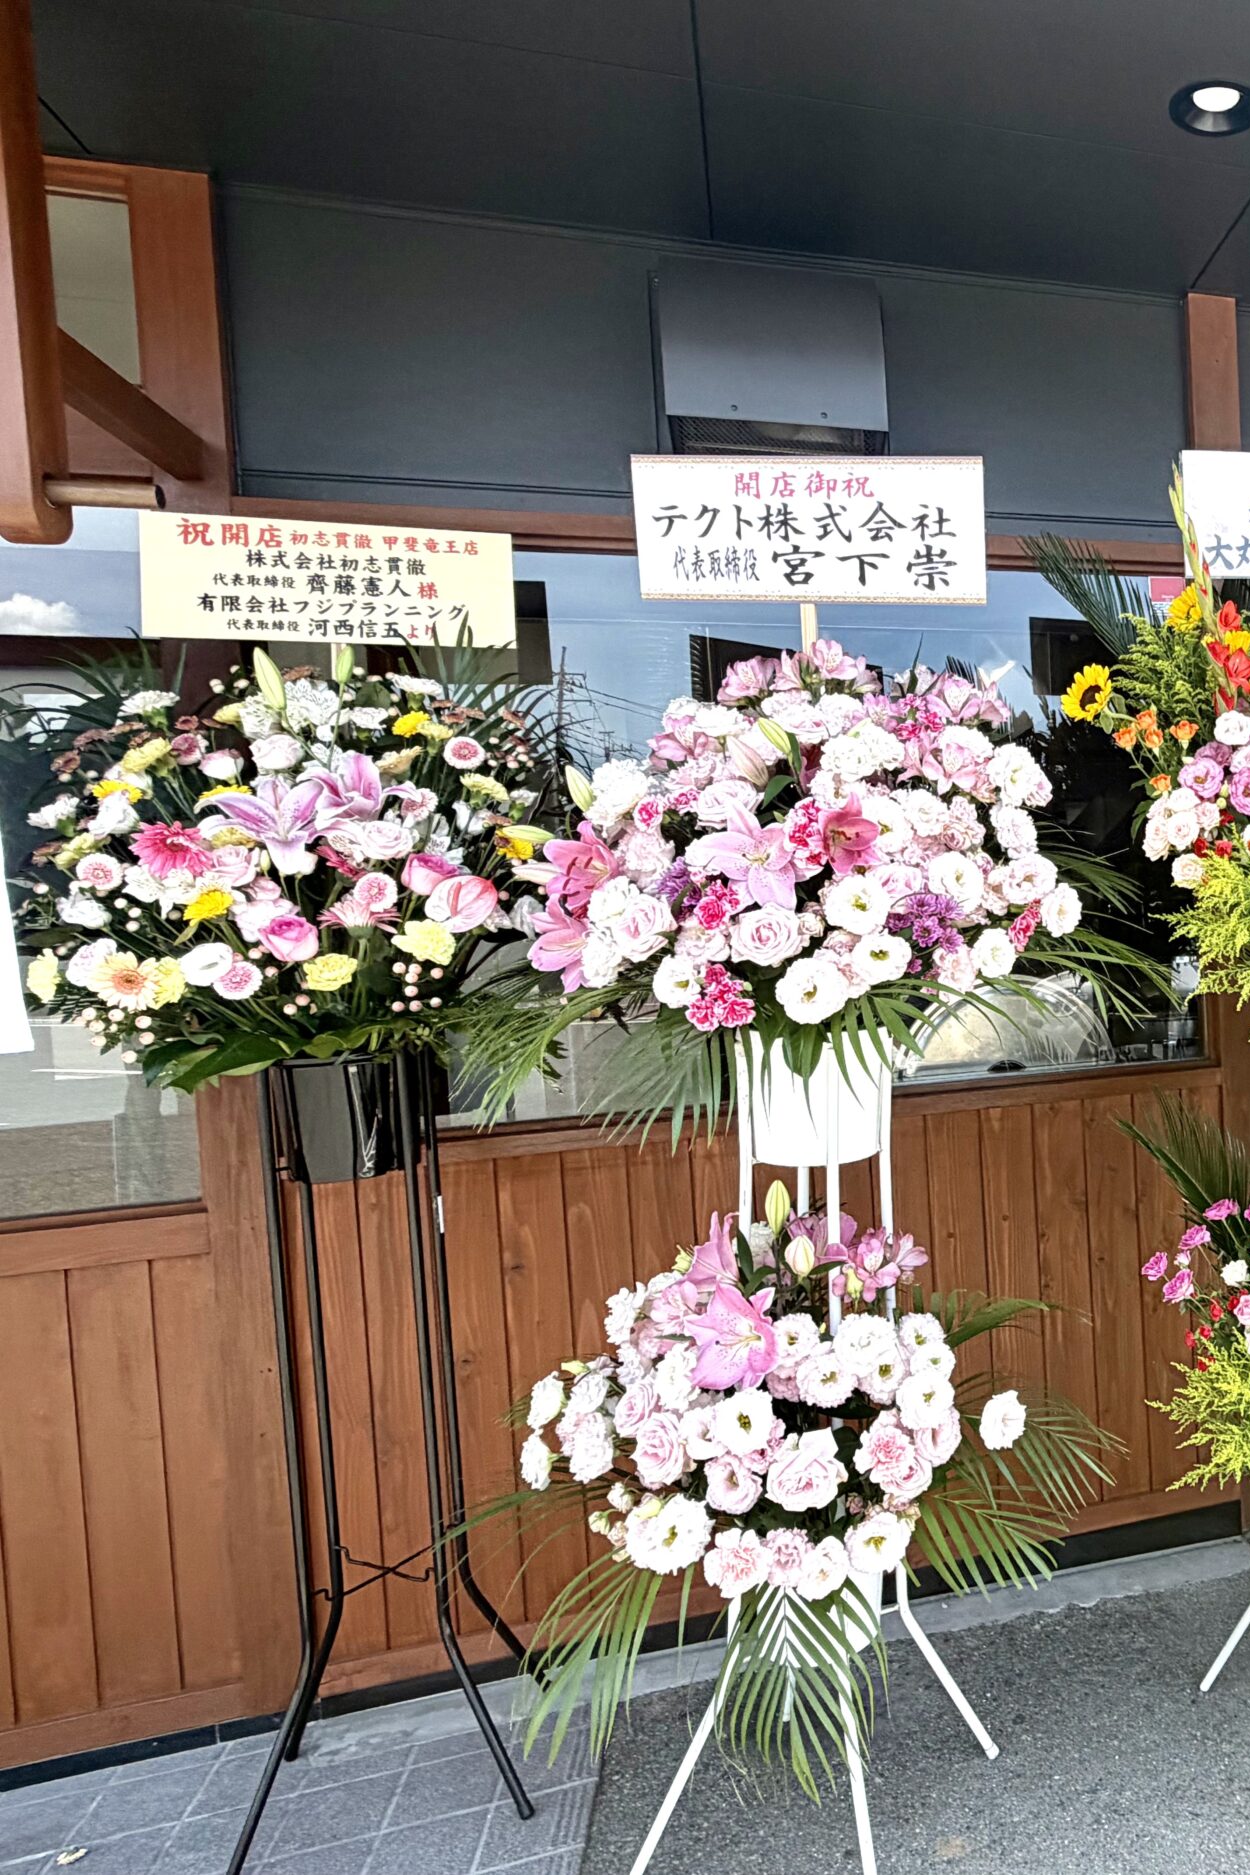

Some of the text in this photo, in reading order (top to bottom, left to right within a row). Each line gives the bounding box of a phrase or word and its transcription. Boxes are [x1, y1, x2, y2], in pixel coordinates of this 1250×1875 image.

[733, 471, 875, 499] 開店御祝
[651, 501, 958, 543] テクト株式会社
[245, 549, 427, 576] 株式会社初志貫徹
[197, 592, 467, 621] 有限会社フジプランニング
